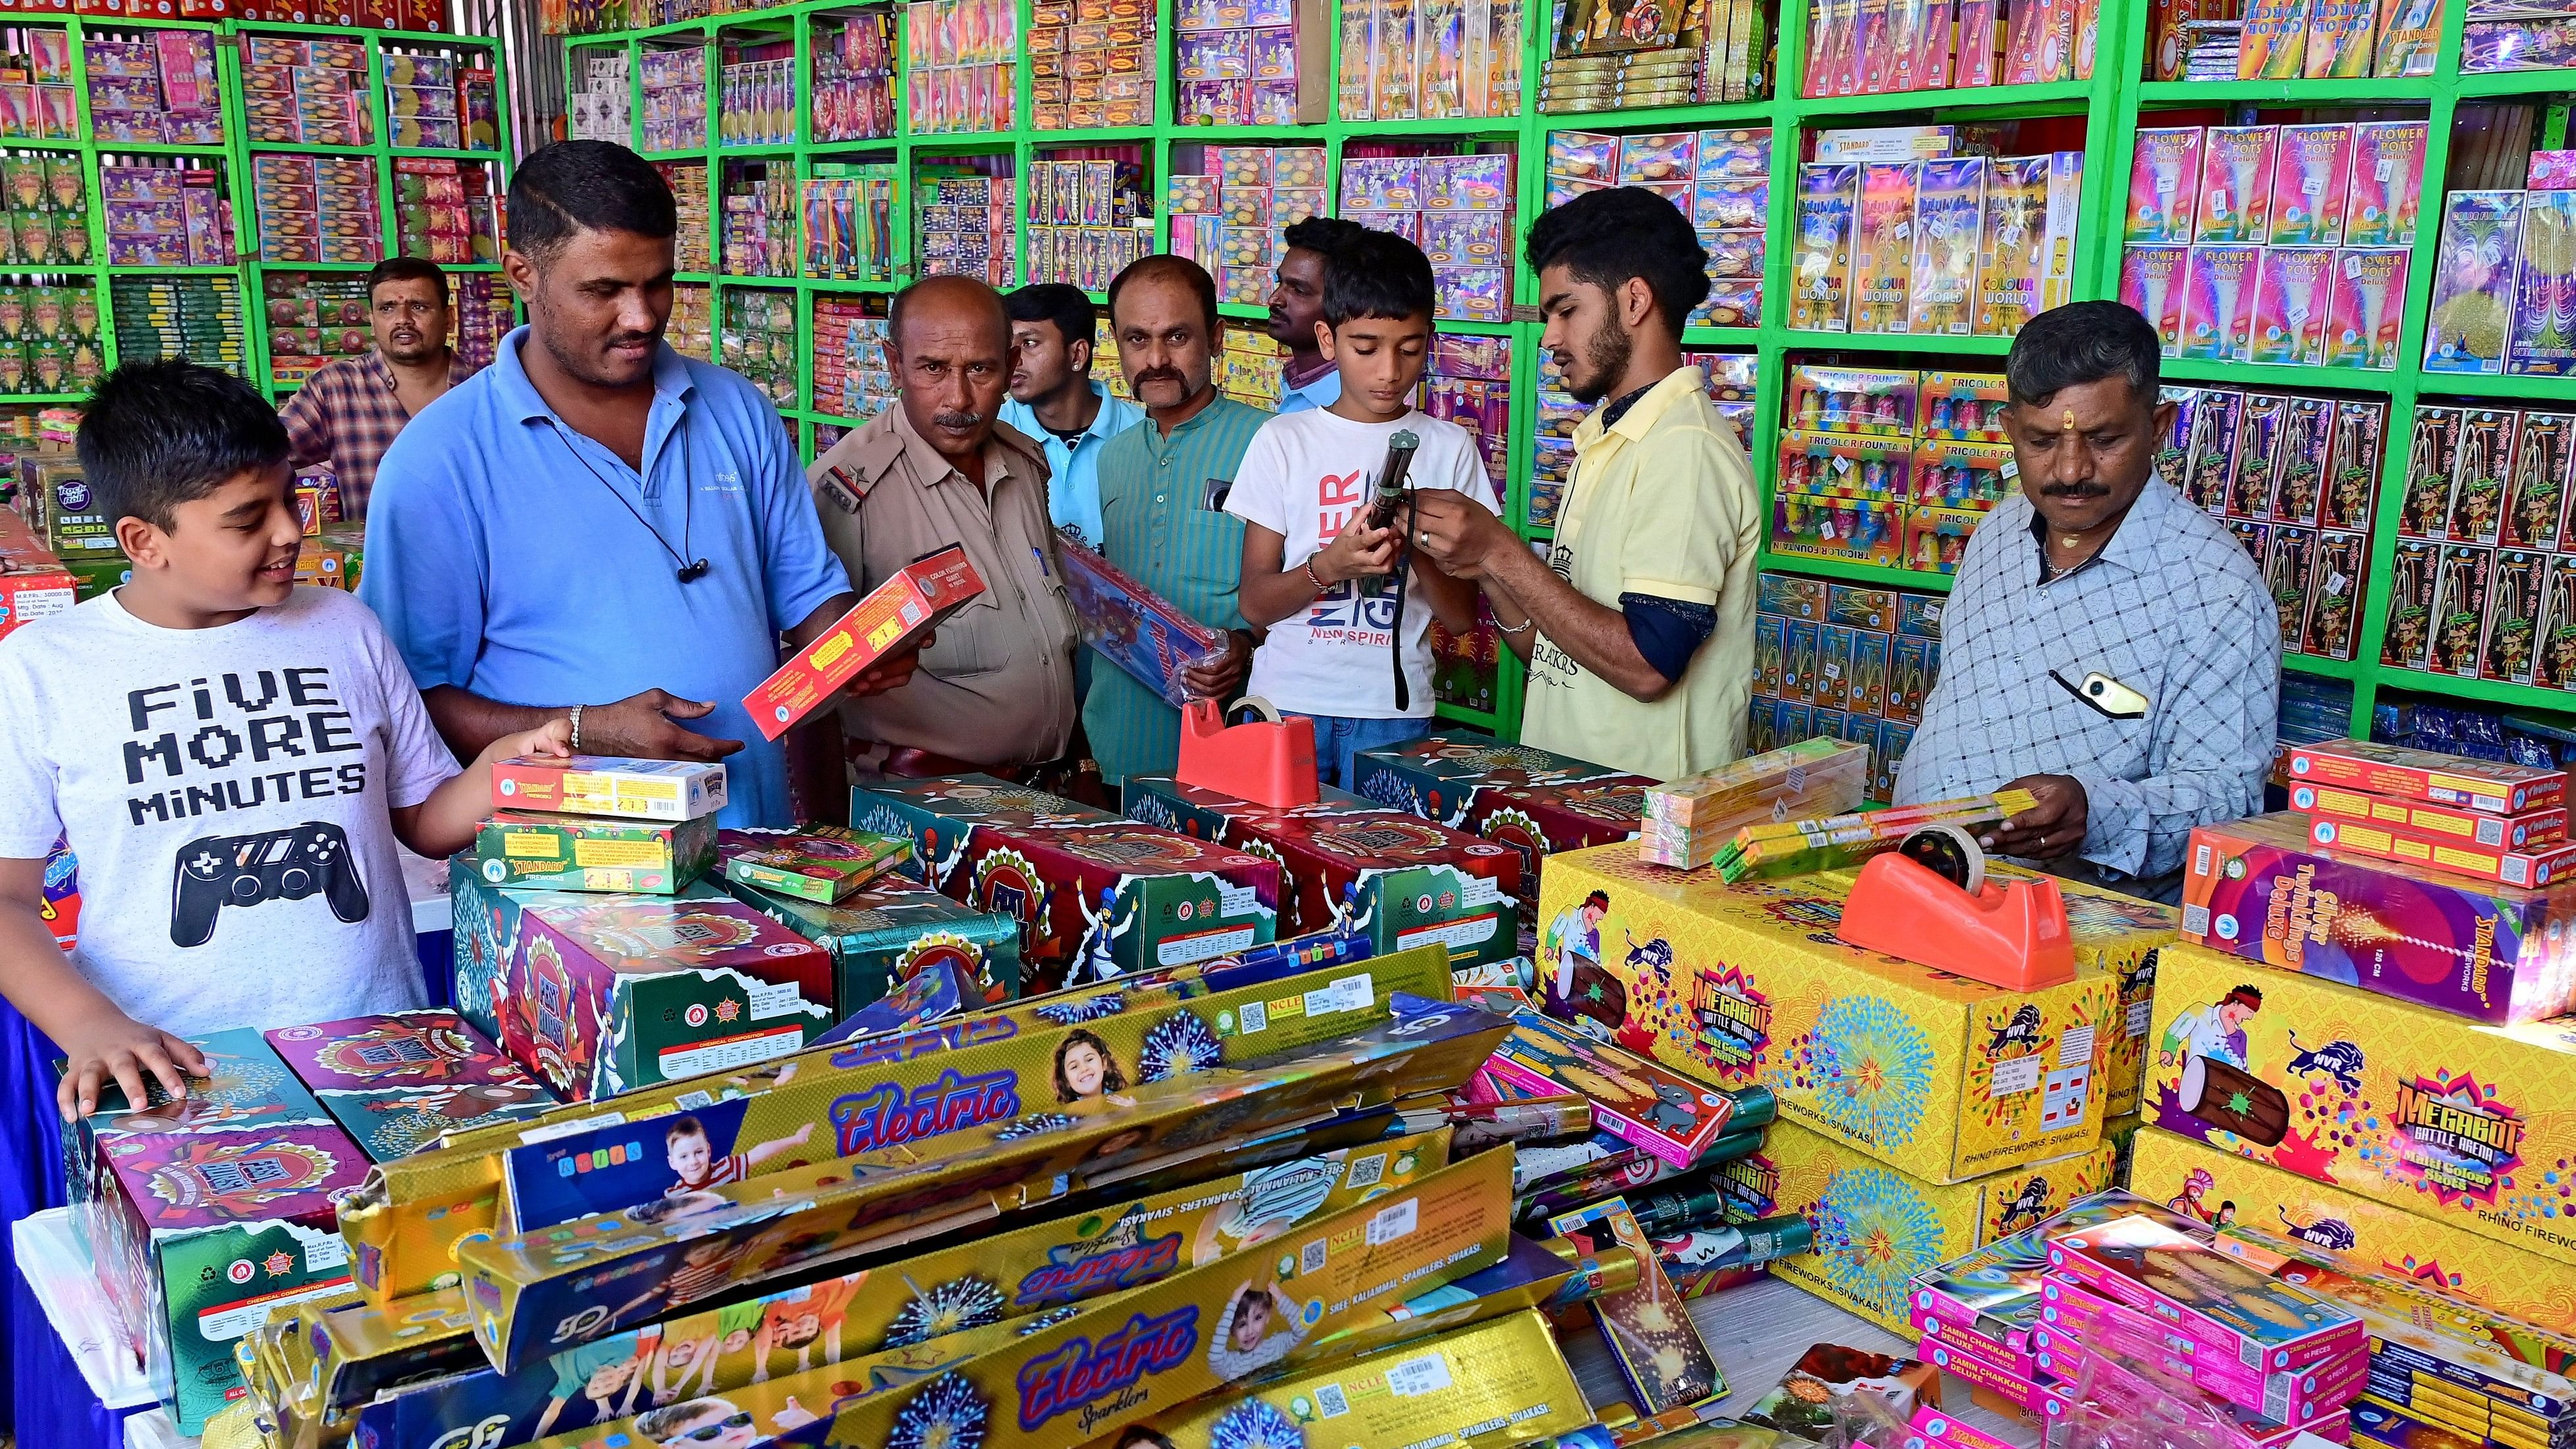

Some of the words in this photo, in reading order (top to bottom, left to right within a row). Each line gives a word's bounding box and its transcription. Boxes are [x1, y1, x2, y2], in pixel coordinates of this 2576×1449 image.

[2247, 19, 2302, 35] COLOR
[2316, 18, 2371, 34] COLOR
[2148, 133, 2194, 145] FLOWER
[2223, 133, 2271, 143] FLOWER
[2296, 131, 2346, 142] FLOWER
[2371, 128, 2424, 139] FLOWER
[2155, 144, 2185, 155] POTS
[2232, 143, 2262, 155] POTS
[2305, 143, 2337, 153] POTS
[2381, 140, 2414, 152] POTS
[2137, 251, 2183, 262] FLOWER
[2206, 251, 2253, 262] FLOWER
[2278, 252, 2328, 264] FLOWER
[2144, 262, 2173, 272] POTS
[2214, 262, 2244, 274] POTS
[2286, 264, 2318, 275] POTS
[2361, 266, 2392, 278] POTS
[1862, 276, 1906, 290] COLOUR
[1983, 278, 2034, 291] COLOUR
[1862, 291, 1902, 303] WORLD
[1983, 291, 2030, 304] WORLD
[1952, 378, 2005, 389] TRICOLOR
[2445, 413, 2459, 447] FLOWER
[2496, 416, 2512, 450] FLOWER
[1808, 436, 1858, 448] TRICOLOR
[1859, 441, 1910, 453] FOUNTAIN
[1944, 446, 1997, 459] TRICOLOR
[1772, 541, 1820, 554] FOUNTAIN
[1821, 547, 1870, 560] TRICOLOR
[929, 570, 946, 580] COLOR
[945, 561, 968, 575] FLOWERS
[2423, 546, 2437, 579] FLOWER
[2473, 552, 2488, 585] FLOWER
[945, 573, 960, 583] GIANT
[2528, 557, 2543, 591] FLOWER
[1311, 627, 1343, 639] NEW
[123, 712, 363, 784] MORE
[2267, 875, 2294, 941] Deluxe
[2282, 863, 2316, 964] Twinklings
[1445, 918, 1471, 927] COMPOSITION
[2309, 889, 2339, 946] Silver
[1203, 927, 1229, 936] COMPOSITION
[1641, 949, 1659, 964] HVR
[2374, 948, 2384, 966] 120
[2372, 967, 2382, 978] CM
[2460, 944, 2475, 993] FIREWORKS
[1270, 997, 1300, 1012] NCLE
[1693, 975, 1772, 1035] MEGABOT
[1731, 1019, 1753, 1041] ARENA
[2006, 1024, 2026, 1039] HVR
[699, 1039, 727, 1048] CHEMICAL
[727, 1032, 764, 1043] COMPOSITION
[1698, 1031, 1721, 1048] Multi
[1721, 1041, 1753, 1062] Colour
[1711, 1046, 1738, 1066] Shots
[2314, 1054, 2343, 1071] HVR
[833, 1071, 1016, 1156] Electric
[2397, 1083, 2526, 1155] MEGABOT
[1963, 1150, 1993, 1164] RHINO
[2458, 1137, 2494, 1163] ARENA
[2424, 1167, 2467, 1191] Shots
[2442, 1162, 2492, 1186] Colour
[1251, 1171, 1314, 1196] KALIAMMAL
[1737, 1183, 1760, 1206] ARENA
[2016, 1196, 2036, 1212] HVR
[2478, 1210, 2521, 1231] RHINO
[2303, 1228, 2333, 1248] HVR
[1329, 1300, 1350, 1315] SREE
[1352, 1278, 1398, 1304] KALIAMMAL
[1447, 1243, 1483, 1265] SIVAKASI.
[246, 1294, 280, 1306] CHEMICAL
[280, 1283, 325, 1297] COMPOSITION
[1941, 1323, 1968, 1341] ZAMIN
[1970, 1336, 2017, 1362] CHAKKARS
[2289, 1342, 2307, 1354] ZAMIN
[2307, 1333, 2337, 1348] CHAKKARS
[2336, 1326, 2359, 1338] ASHOKA
[1941, 1332, 1973, 1352] DELUXE
[1994, 1356, 2016, 1371] PIECES
[2310, 1344, 2332, 1358] PIECES
[1019, 1309, 1197, 1427] Electric
[1950, 1355, 1978, 1373] ZAMIN
[1980, 1367, 2028, 1394] CHAKKARS
[2332, 1364, 2348, 1379] PIECES
[1349, 1375, 1383, 1393] NCLE
[1950, 1363, 1984, 1383] DELUXE
[2005, 1389, 2027, 1403] PIECES
[2325, 1399, 2331, 1408] 10
[2330, 1390, 2347, 1404] PIECES
[1077, 1385, 1149, 1434] Sparklers
[1458, 1415, 1510, 1440] SPARKLERS,
[1510, 1402, 1552, 1425] SIVAKASI.
